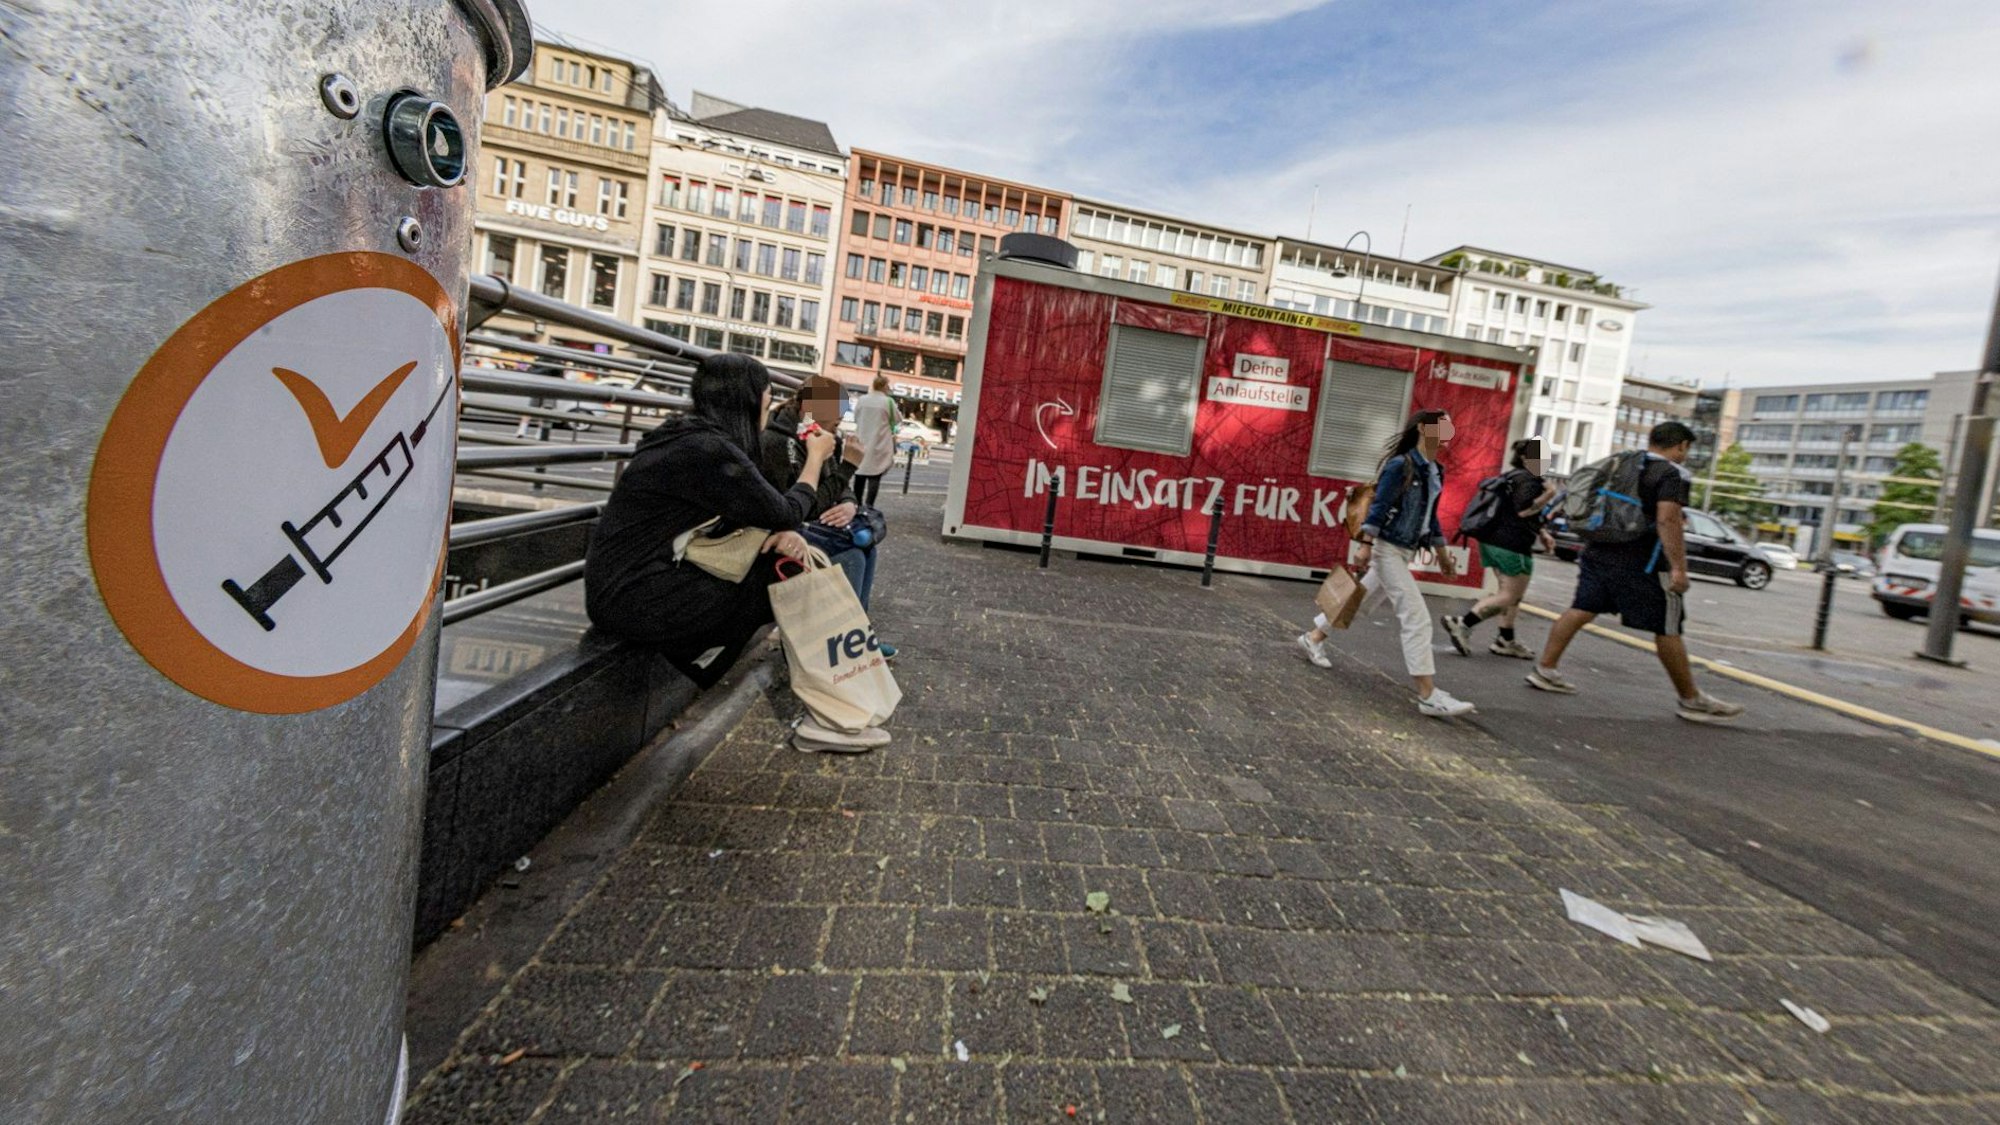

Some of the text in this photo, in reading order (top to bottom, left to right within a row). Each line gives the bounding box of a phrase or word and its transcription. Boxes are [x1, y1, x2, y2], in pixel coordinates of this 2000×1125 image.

[506, 199, 609, 232] FIVE GUYS
[1221, 302, 1314, 327] MIETCONTAINER
[1240, 358, 1284, 377] Deine
[1213, 381, 1303, 405] Anlaufstelle
[1024, 458, 1065, 498] IM
[1233, 477, 1301, 522] FÜR
[1311, 486, 1353, 528] K
